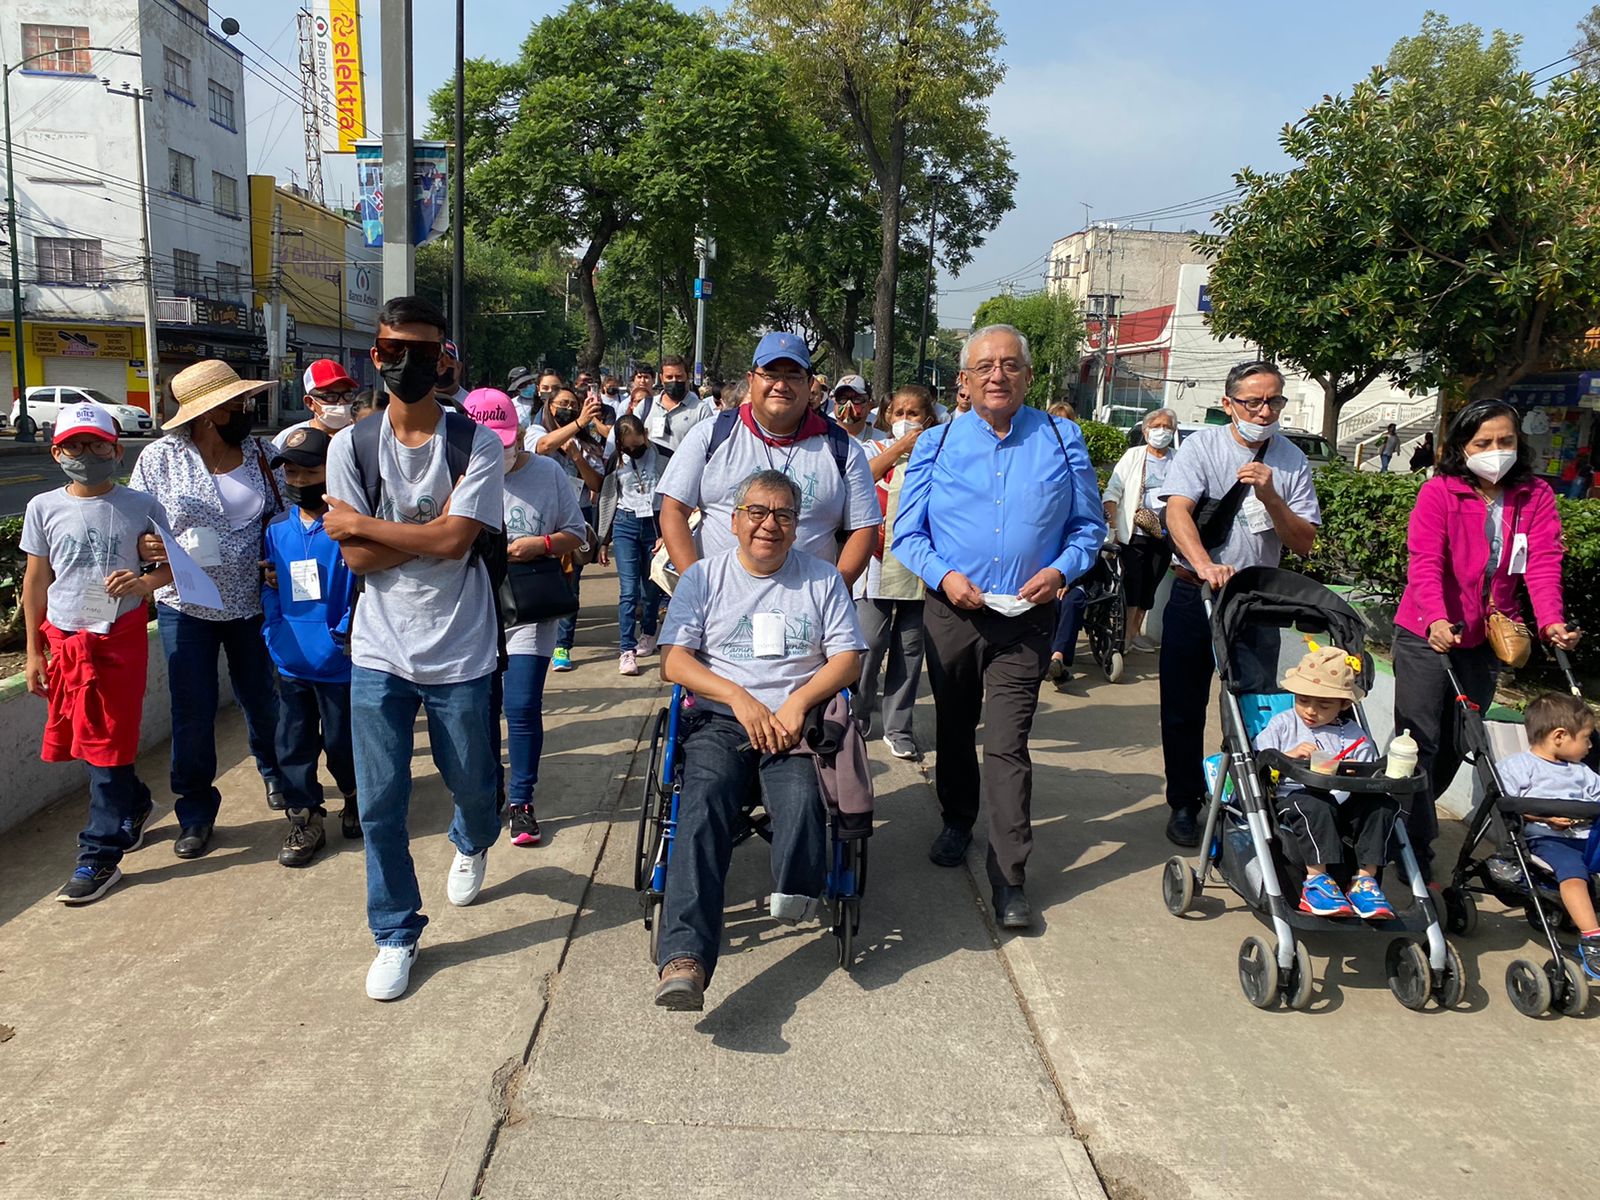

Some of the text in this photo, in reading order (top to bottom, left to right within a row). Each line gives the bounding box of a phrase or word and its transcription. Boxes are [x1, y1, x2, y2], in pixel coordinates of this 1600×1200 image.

[317, 41, 332, 127] Banco Azteca
[334, 41, 359, 130] elektra
[349, 289, 378, 306] Banco Azteca
[467, 404, 508, 425] Zapata
[722, 642, 754, 656] Camin
